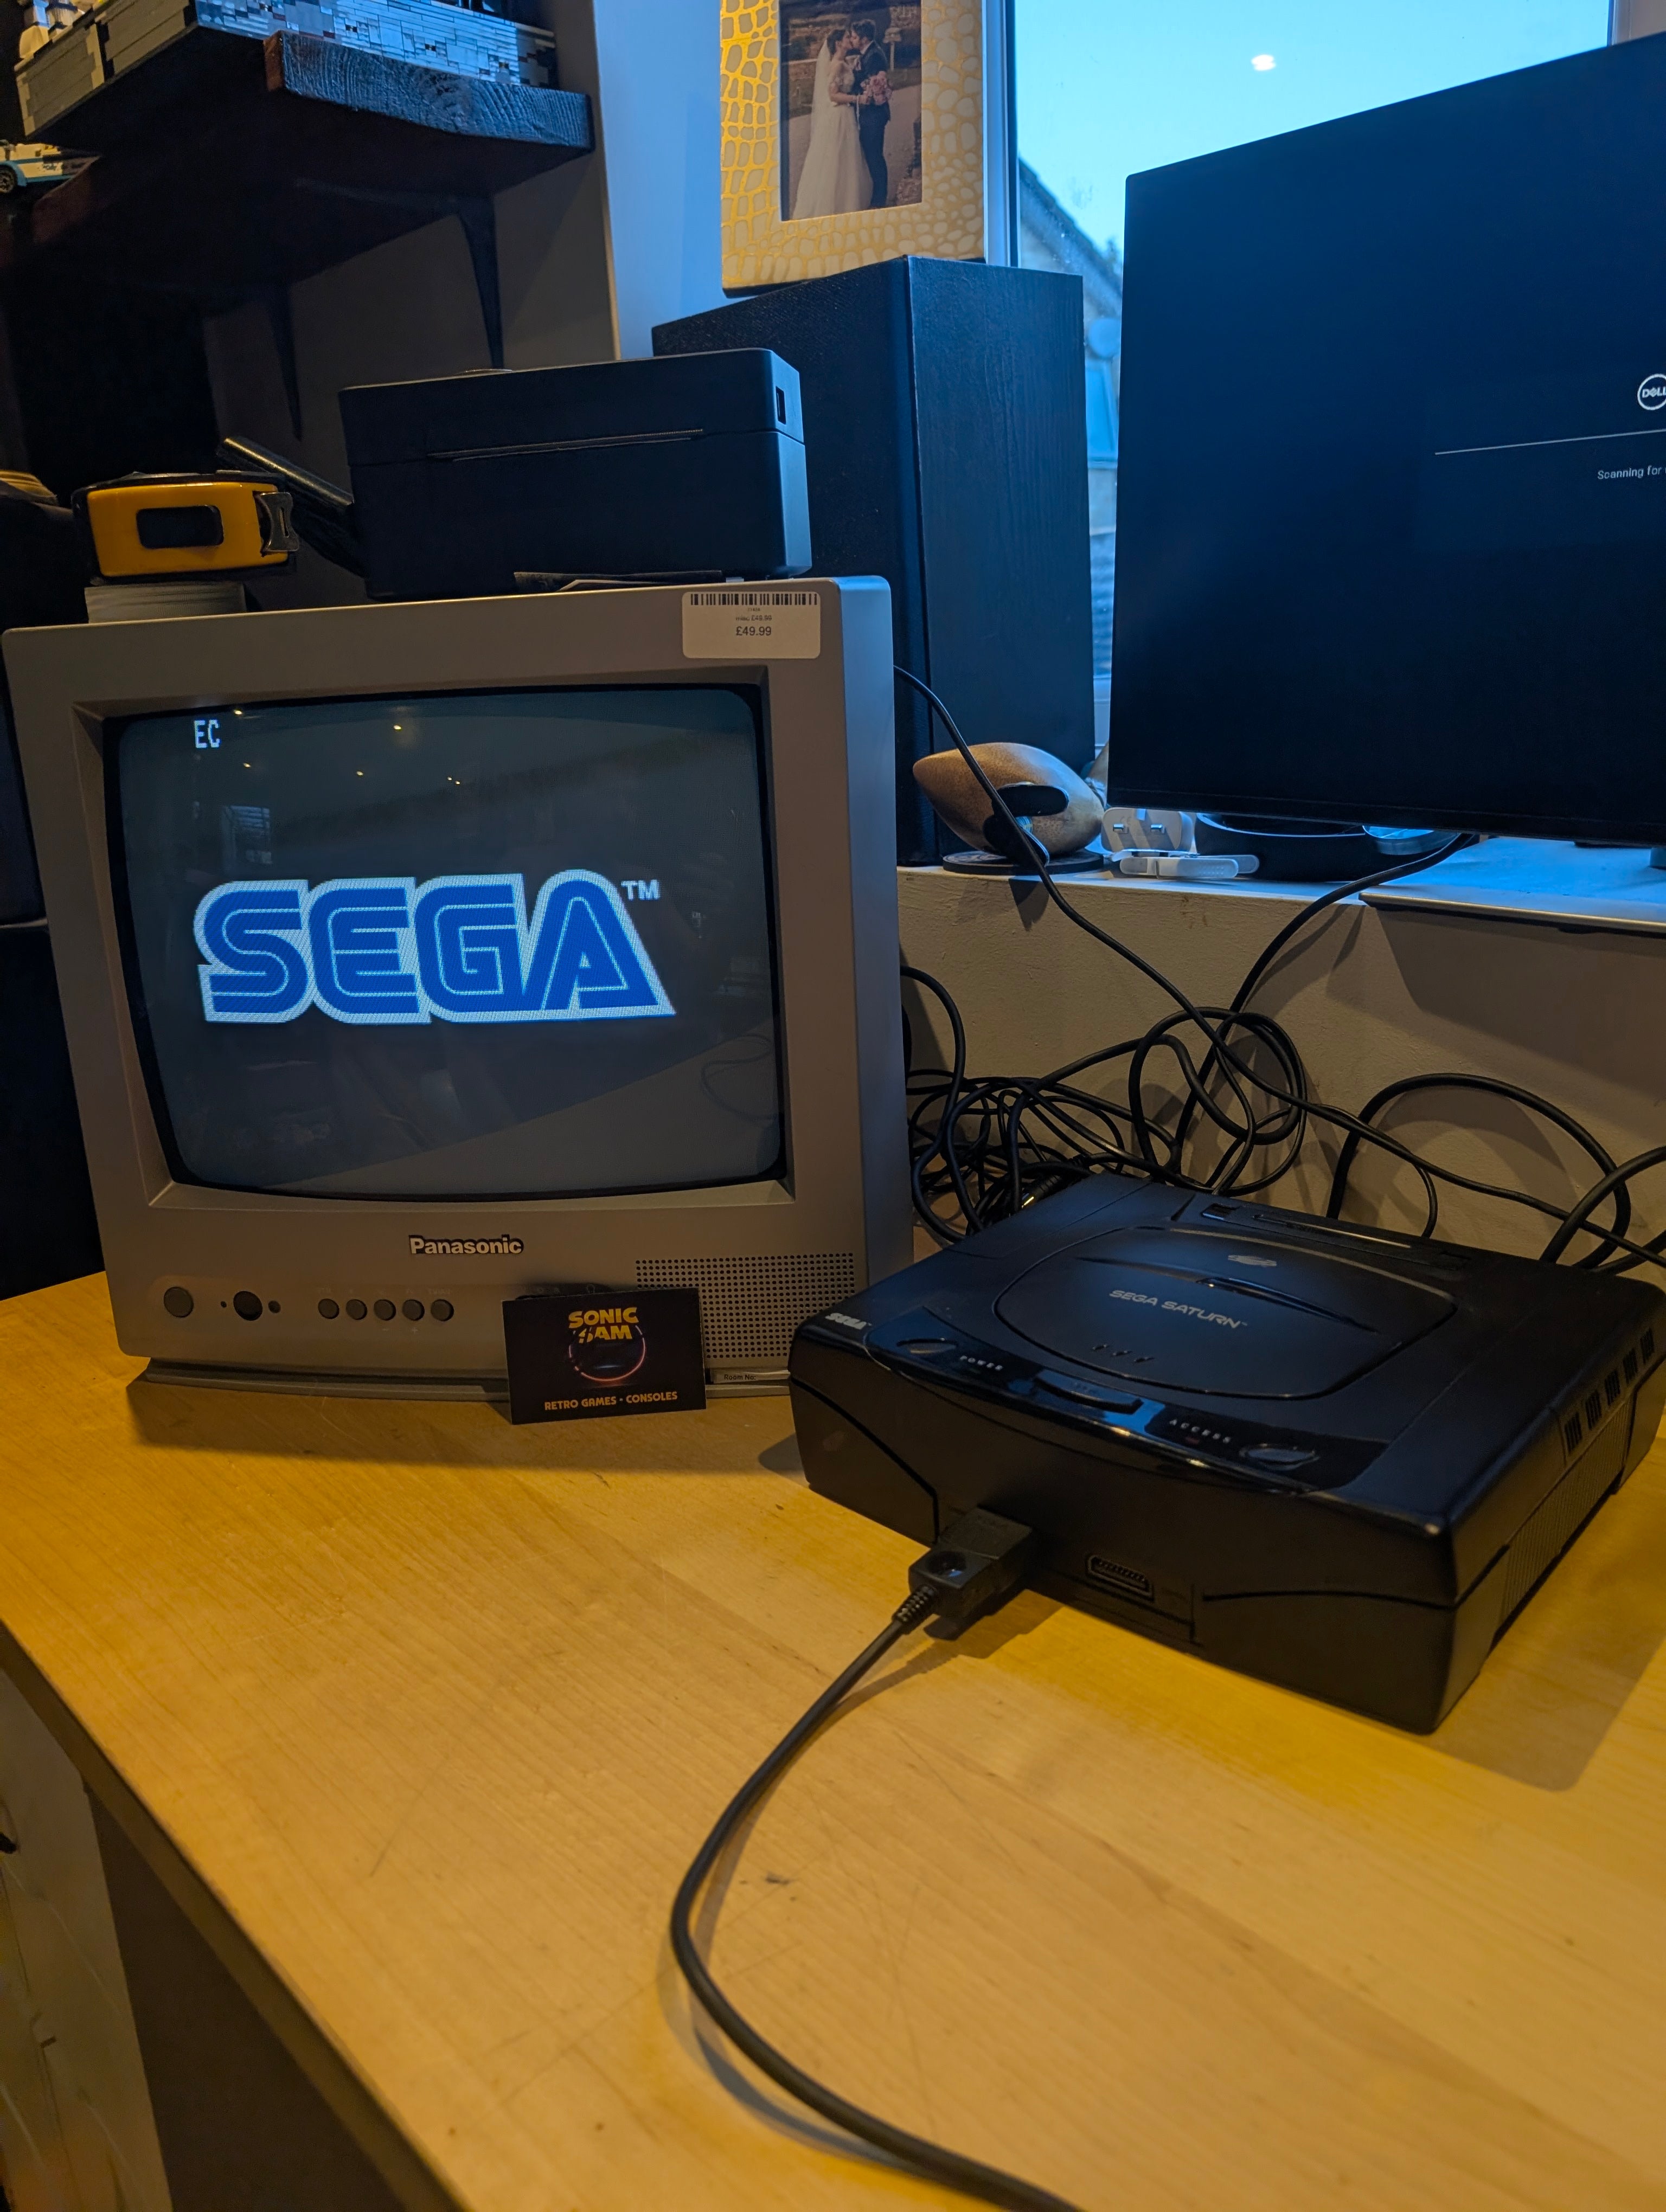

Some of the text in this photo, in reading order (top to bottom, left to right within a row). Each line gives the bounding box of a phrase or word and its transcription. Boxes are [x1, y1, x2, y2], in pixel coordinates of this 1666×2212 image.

[1642, 387, 1666, 398] DELL
[1598, 467, 1644, 480] Scanning
[1647, 465, 1662, 475] for
[736, 626, 772, 636] £49.99
[194, 719, 220, 748] EC
[193, 870, 676, 1024] SEGA TM
[409, 1235, 523, 1254] Panasonic
[568, 1307, 639, 1329] SONIC
[1109, 1290, 1241, 1328] SEGA SATURN
[544, 1399, 579, 1411] RETRO
[581, 1396, 617, 1407] GAMES
[626, 1391, 678, 1404] CONSOLES
